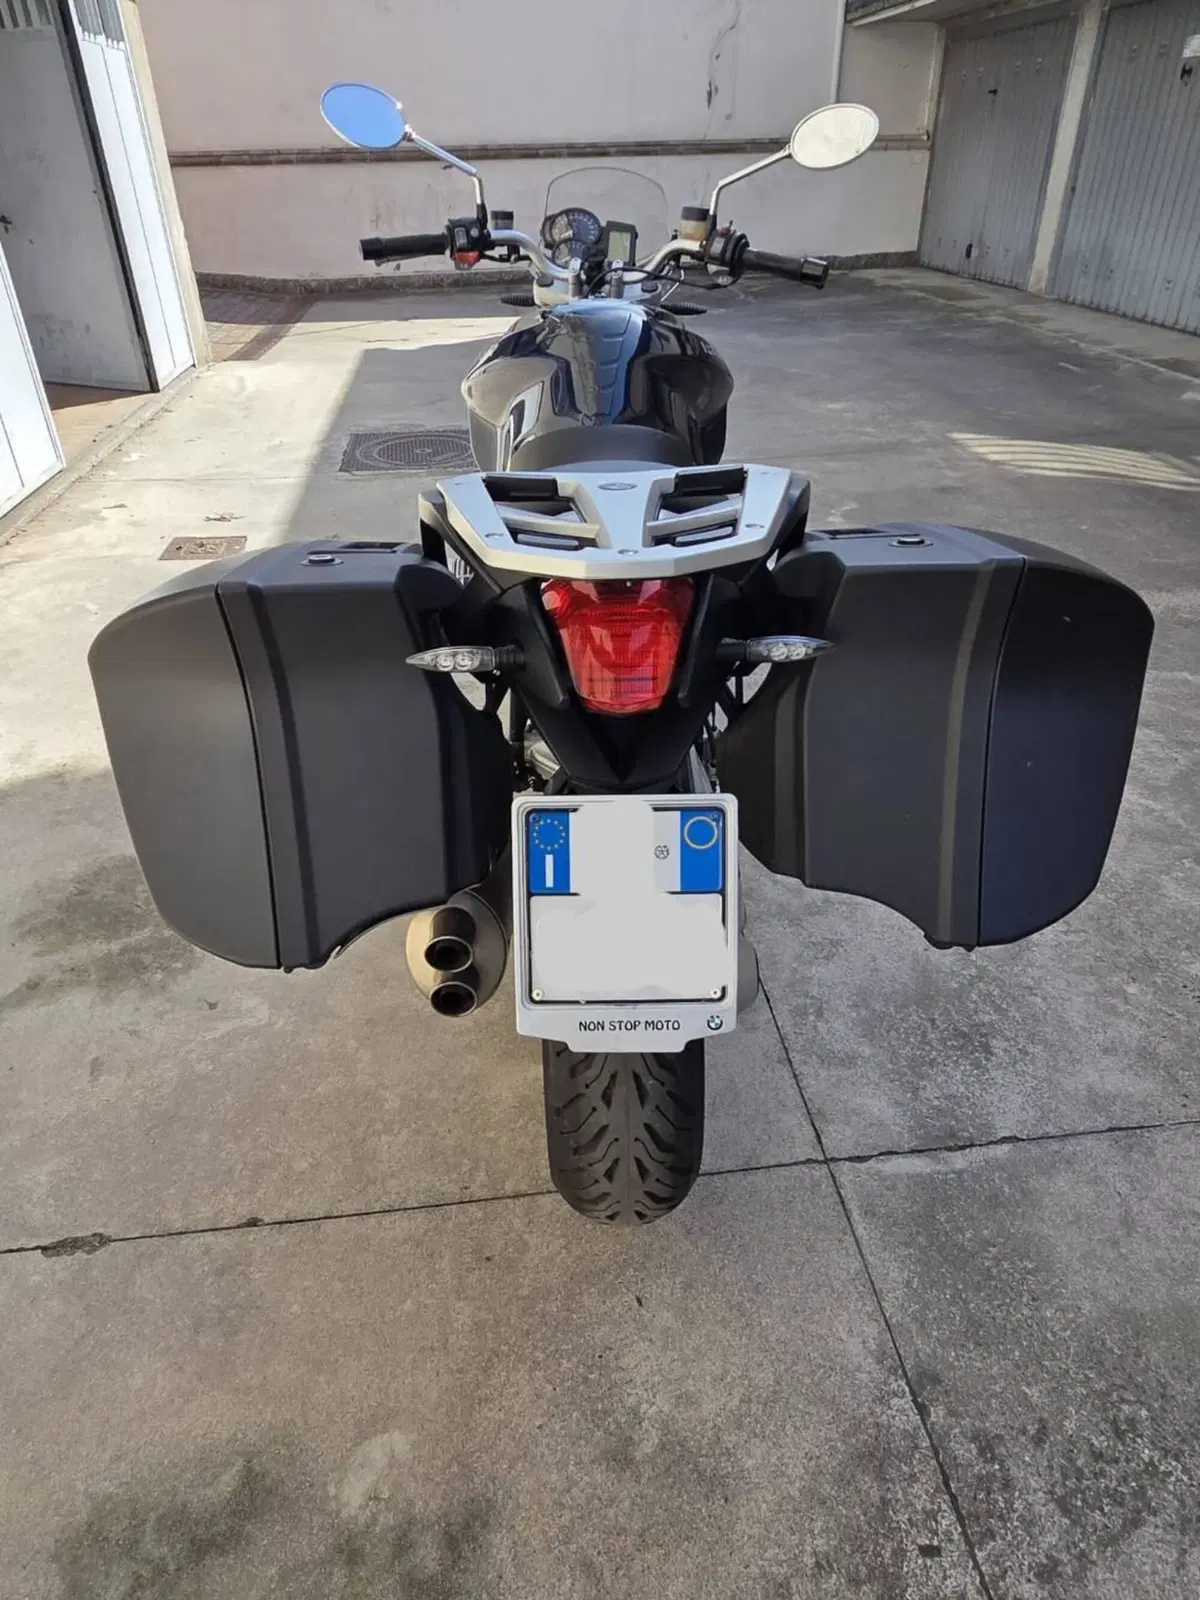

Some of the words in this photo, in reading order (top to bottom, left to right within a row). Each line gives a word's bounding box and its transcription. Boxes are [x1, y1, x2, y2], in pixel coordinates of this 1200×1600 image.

[544, 854, 554, 888] I
[578, 1020, 605, 1032] NON
[608, 1020, 641, 1032] STOP
[644, 1019, 681, 1031] MOTO
